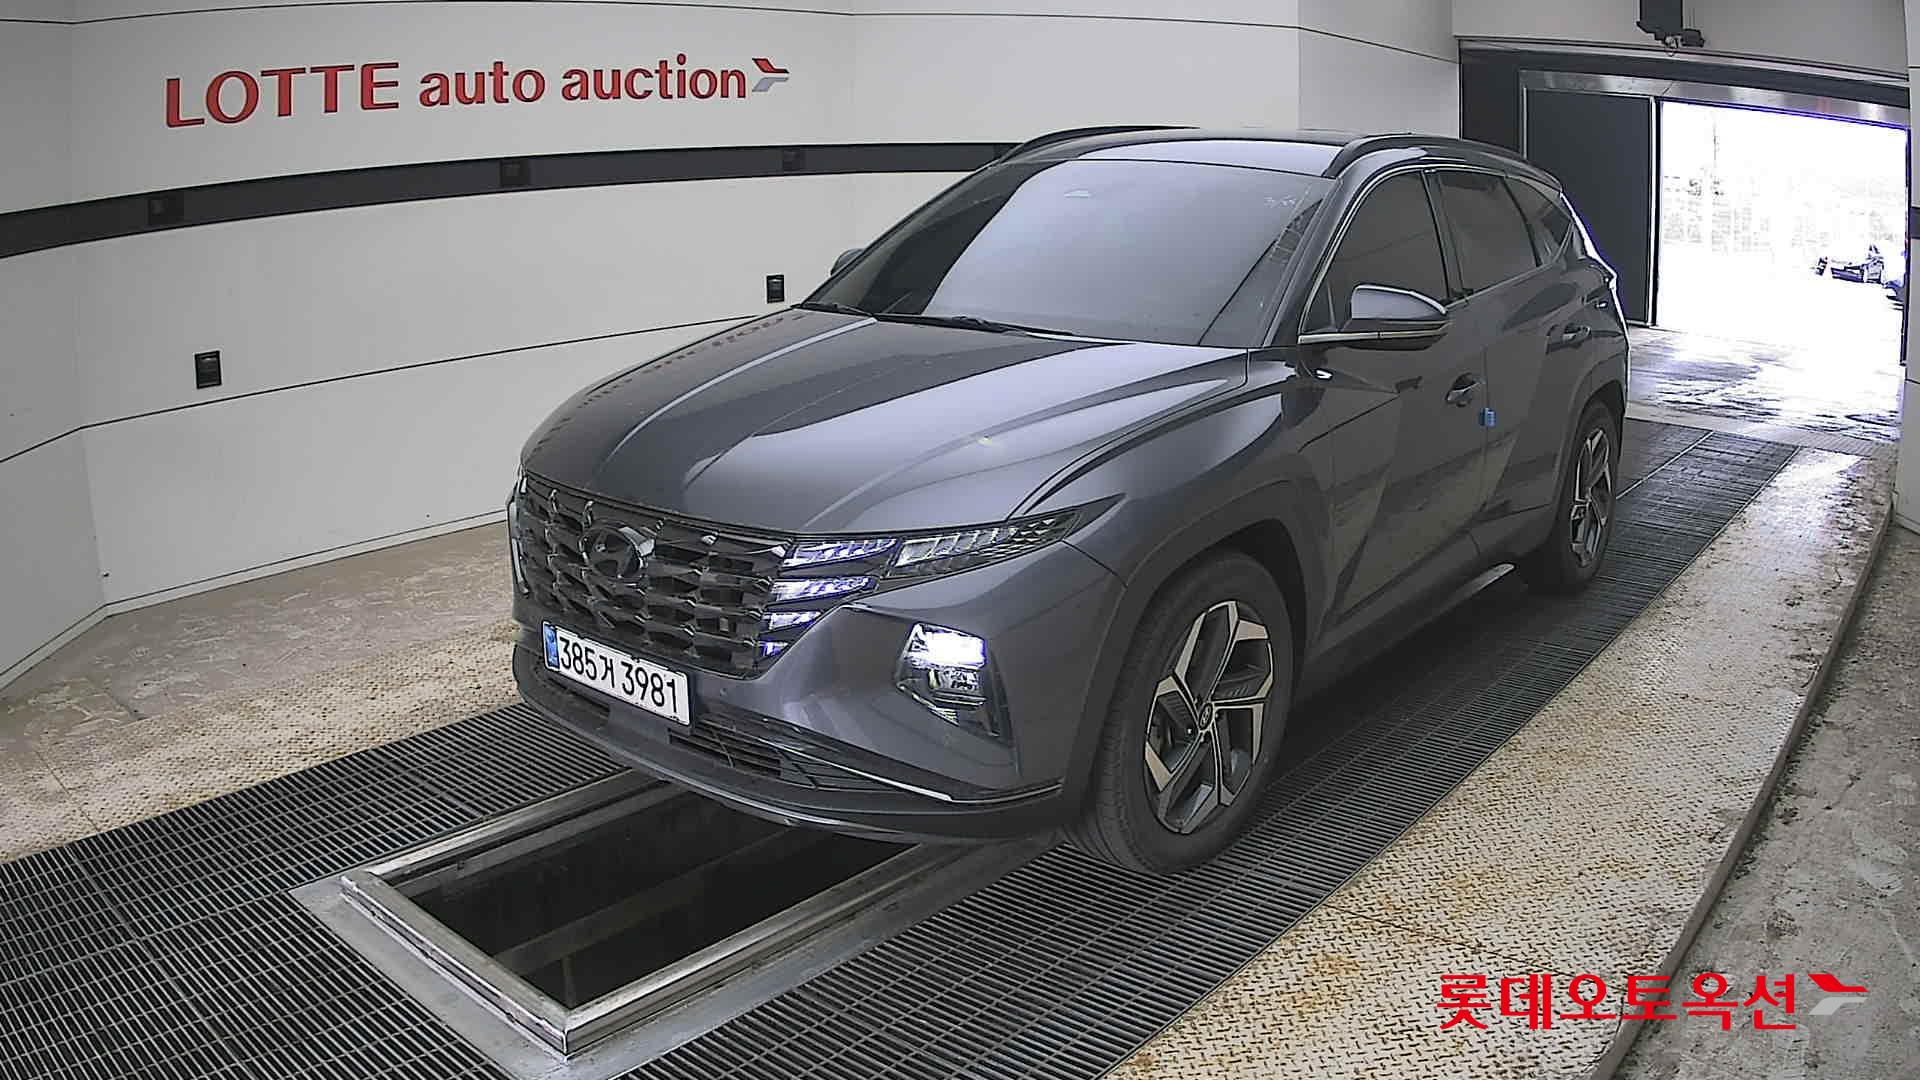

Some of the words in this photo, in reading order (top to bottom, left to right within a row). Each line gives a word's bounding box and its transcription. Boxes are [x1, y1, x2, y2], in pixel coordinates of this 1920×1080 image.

[166, 63, 399, 127] LOTTE
[419, 61, 545, 106] auto
[561, 53, 746, 101] auction
[559, 637, 615, 688] 385거
[620, 661, 677, 713] 3981
